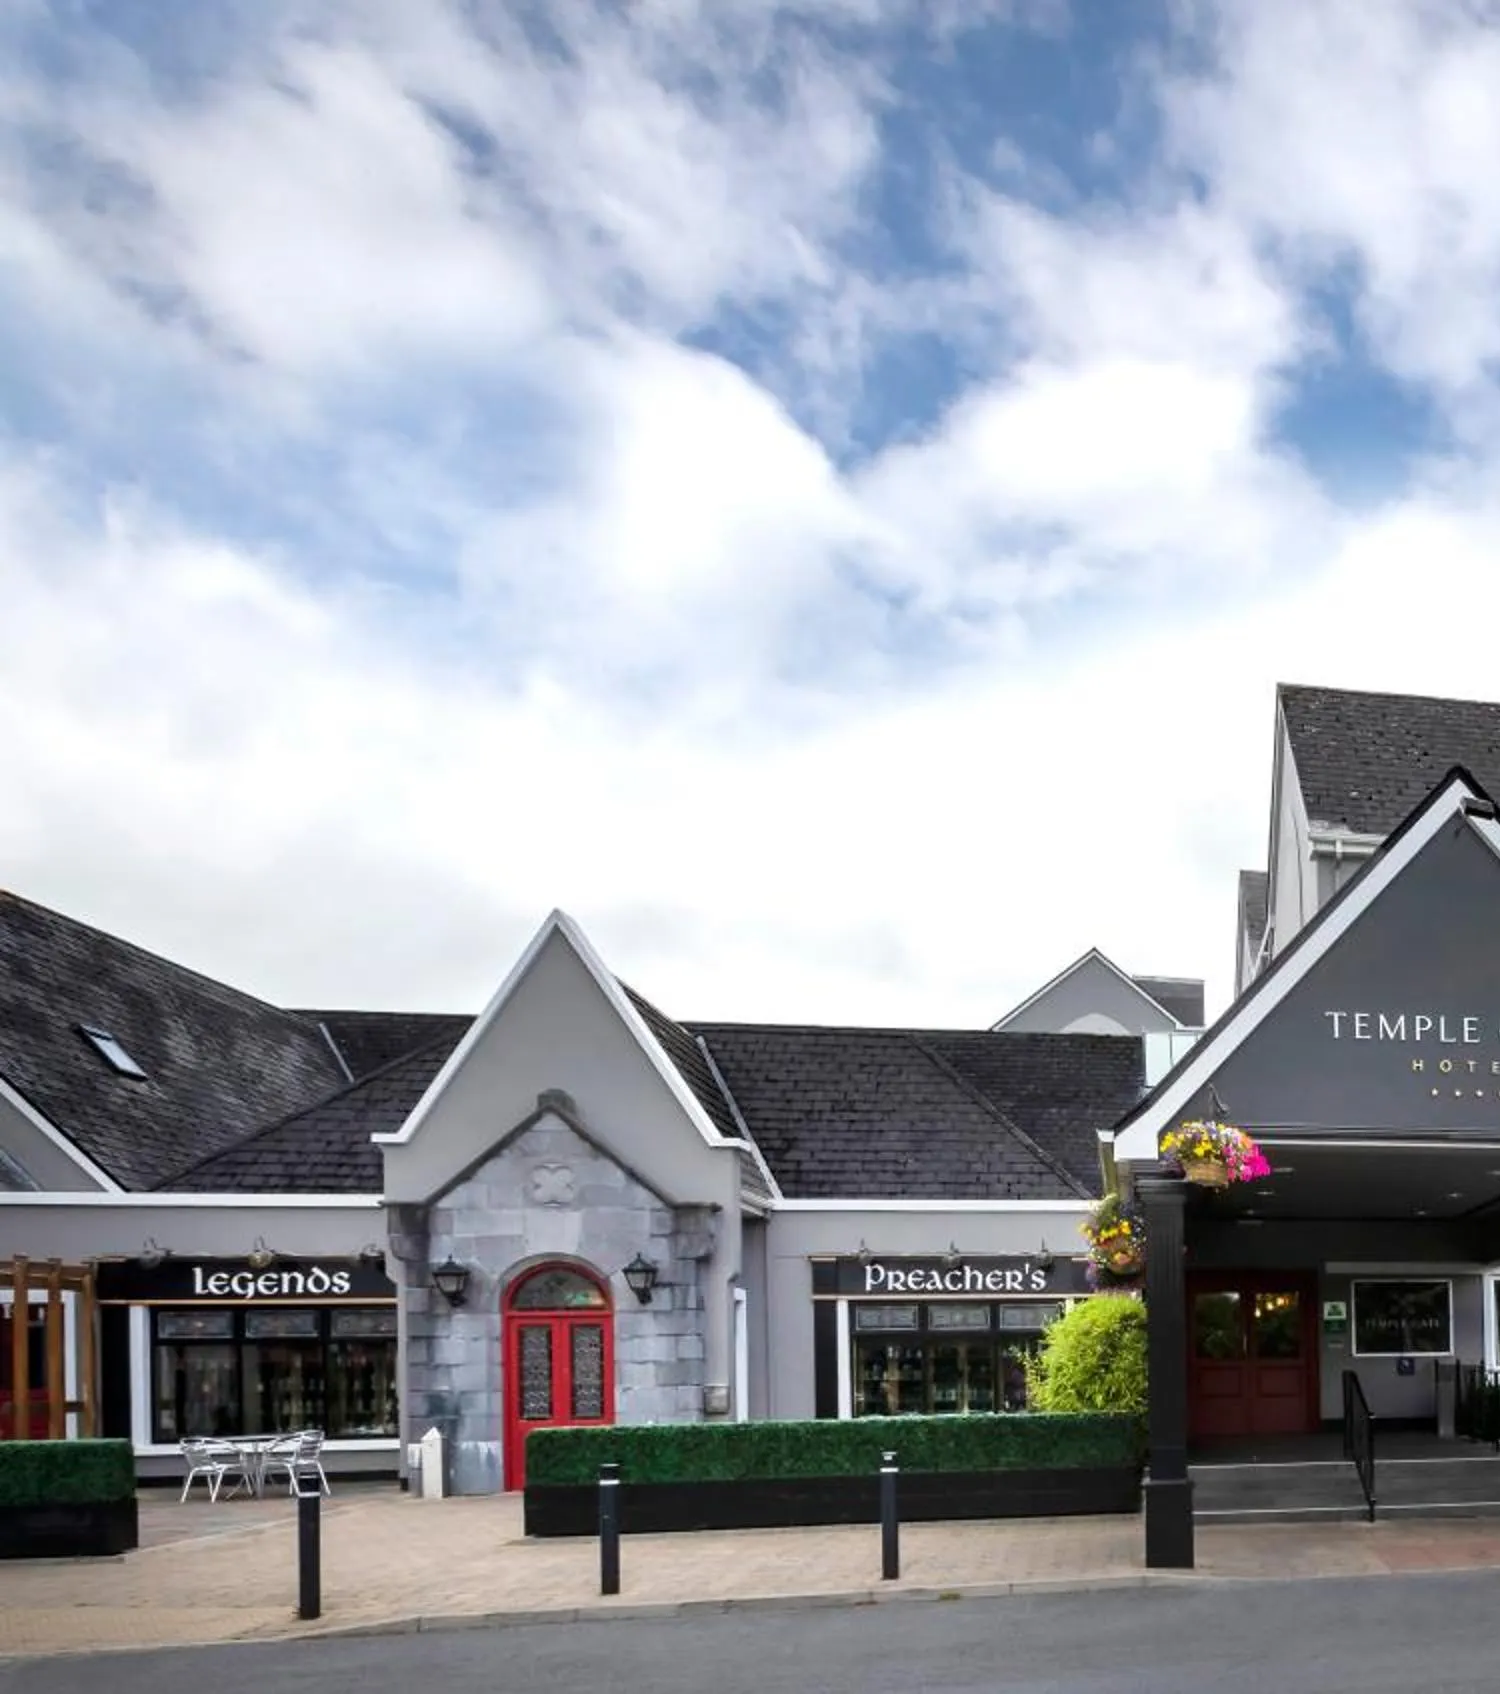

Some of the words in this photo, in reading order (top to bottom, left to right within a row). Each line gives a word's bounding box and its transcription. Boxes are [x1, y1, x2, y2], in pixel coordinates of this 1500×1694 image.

[1324, 1011, 1481, 1043] TEMPLE
[192, 1266, 351, 1299] Legends
[865, 1263, 1047, 1291] Preacher's
